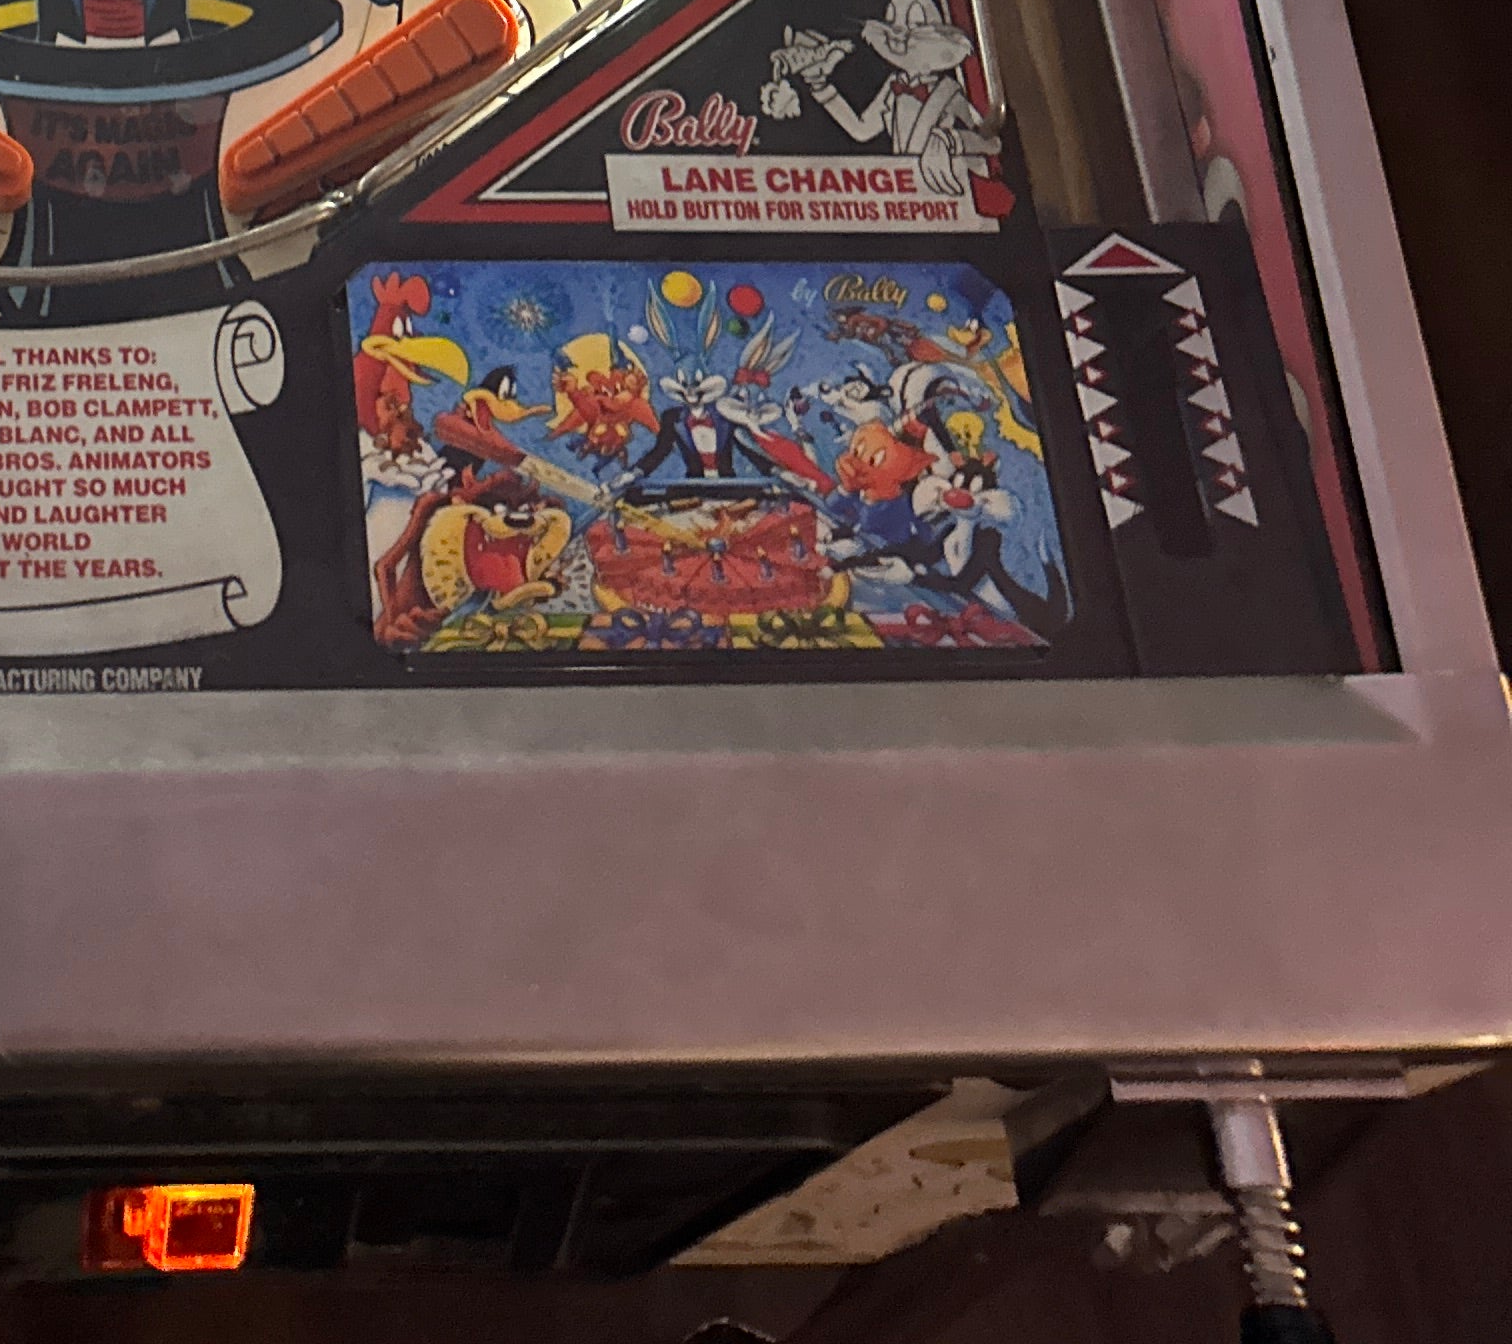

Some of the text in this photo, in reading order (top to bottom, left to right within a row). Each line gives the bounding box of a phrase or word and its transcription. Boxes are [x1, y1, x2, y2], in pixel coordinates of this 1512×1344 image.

[620, 89, 758, 158] Bally
[661, 167, 918, 194] LANE CHANGE
[627, 199, 960, 221] HOLD BUTTON FOR STATUS REPORT
[824, 274, 908, 309] Bally
[12, 347, 112, 367] THANKS
[118, 347, 157, 365] TO:
[1, 373, 57, 392] FRIZ
[62, 373, 180, 394] FRELENG,
[27, 399, 78, 418] BOB
[83, 398, 219, 420] CLAMPETT,
[93, 426, 145, 444] AND
[150, 425, 196, 443] ALL
[68, 451, 212, 470] ANIMATORS
[73, 478, 108, 497] SO
[113, 477, 187, 496] MUCH
[34, 504, 168, 524] LAUGHTER
[1, 533, 92, 552] WORLD
[16, 559, 67, 579] THE
[72, 558, 164, 579] YEARS.
[101, 666, 203, 692] COMPANY
